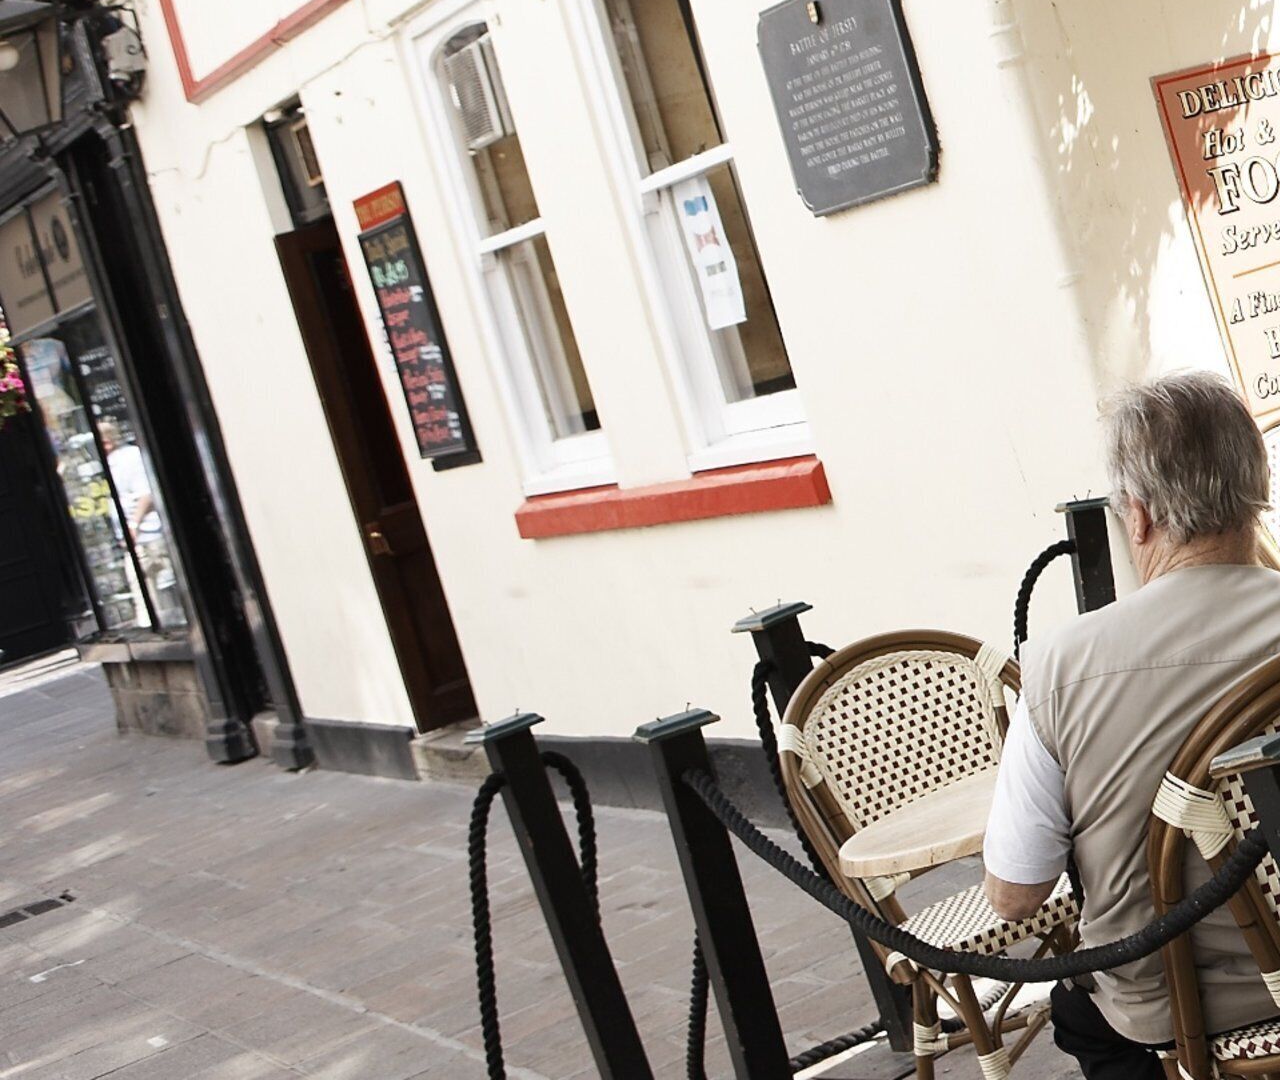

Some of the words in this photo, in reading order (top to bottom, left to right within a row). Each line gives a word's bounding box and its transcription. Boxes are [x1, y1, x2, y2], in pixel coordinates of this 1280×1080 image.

[789, 33, 818, 56] BATTLE
[1202, 126, 1246, 160] Hot
[1254, 117, 1276, 146] &
[1229, 297, 1246, 325] A
